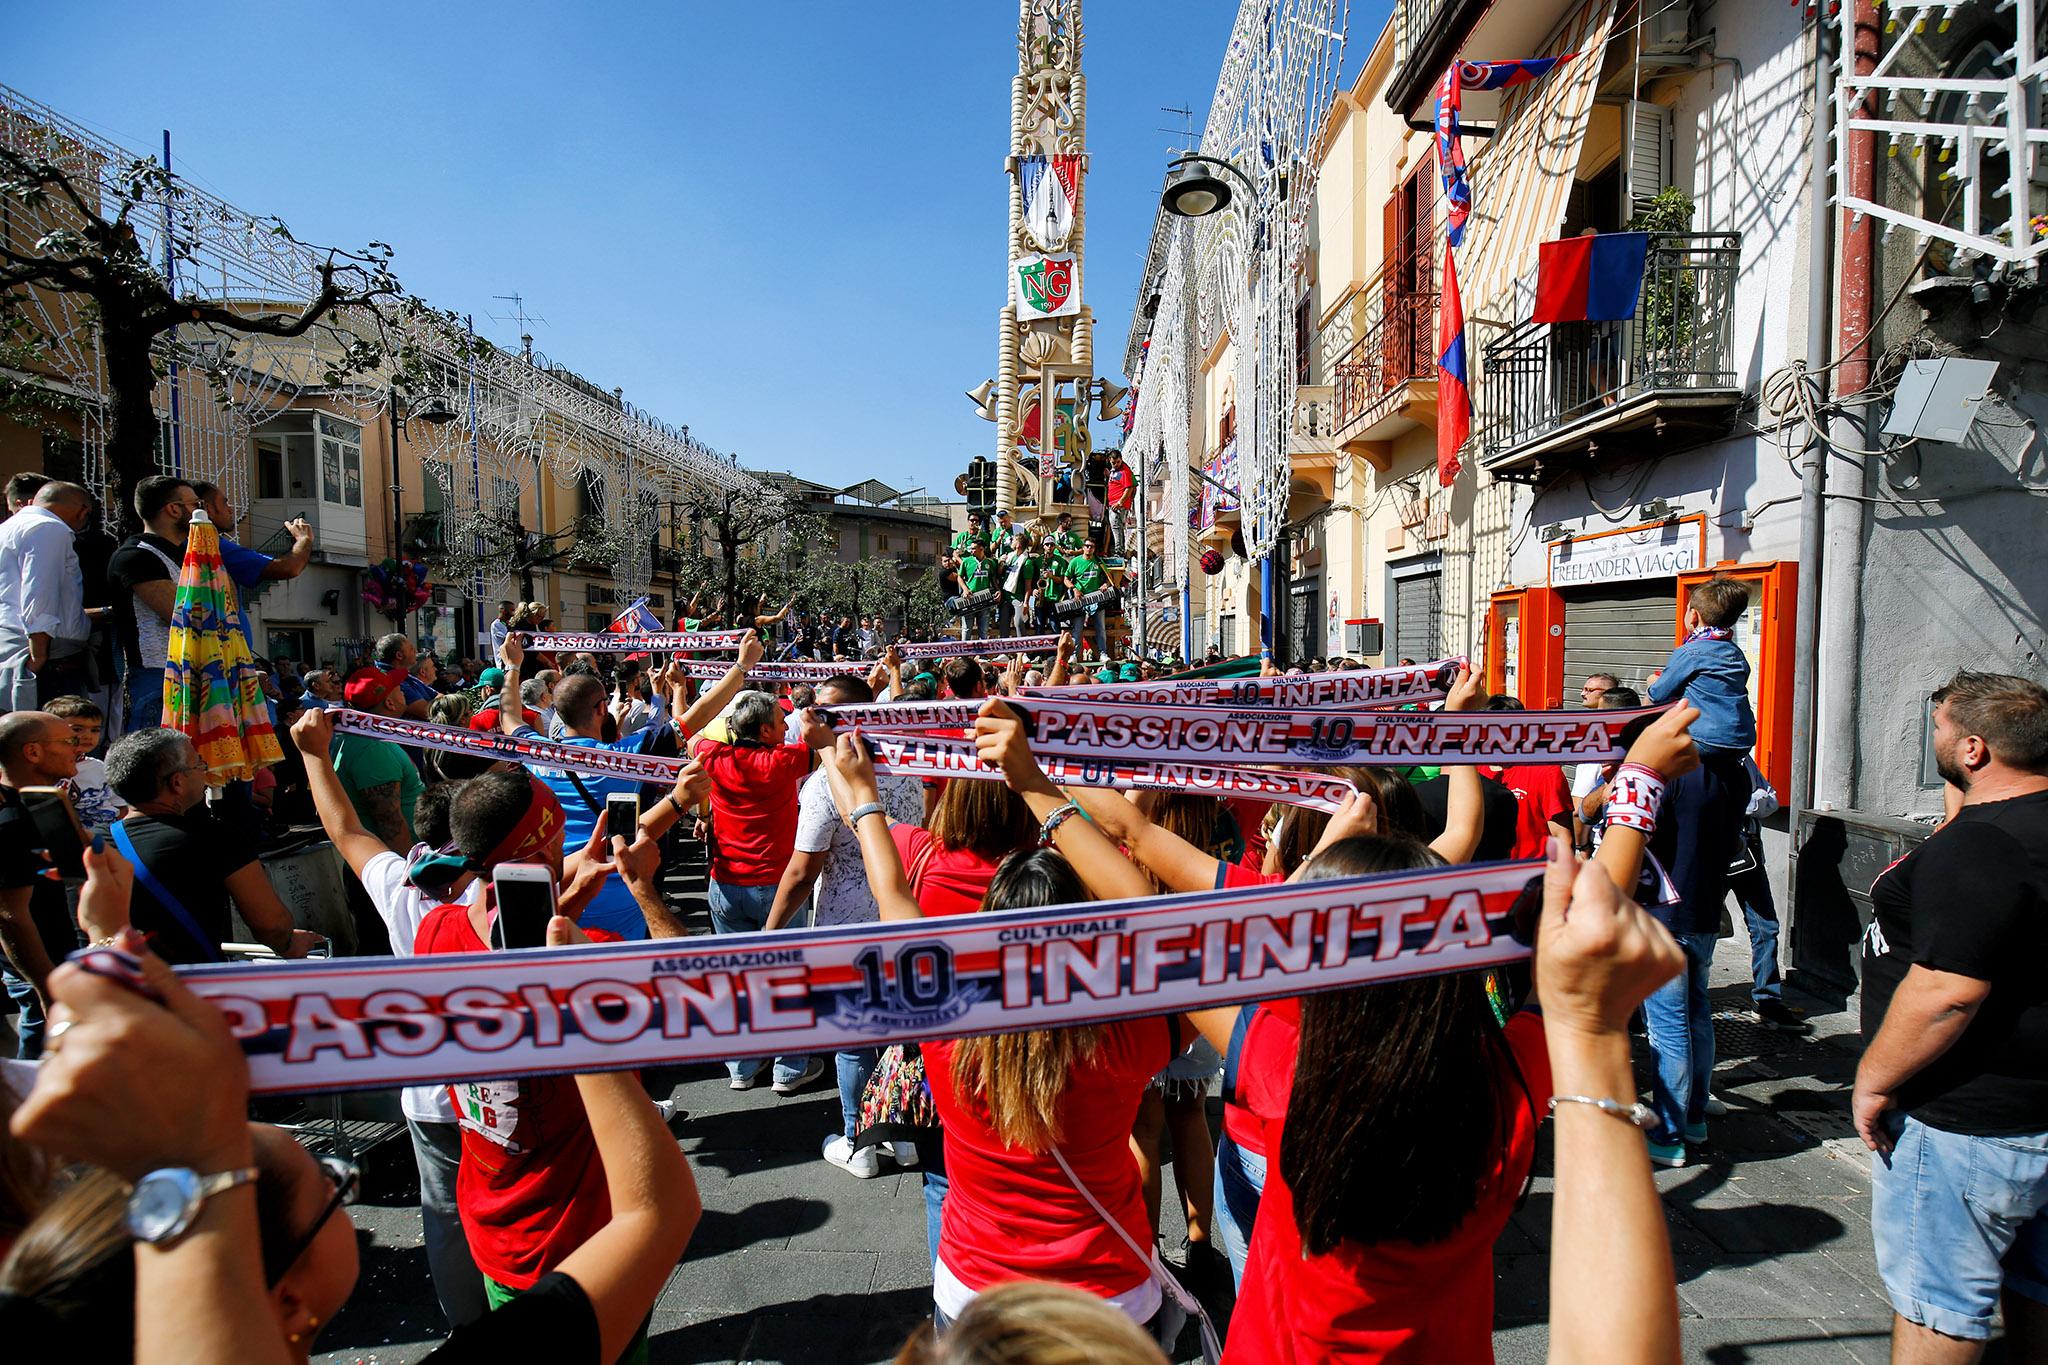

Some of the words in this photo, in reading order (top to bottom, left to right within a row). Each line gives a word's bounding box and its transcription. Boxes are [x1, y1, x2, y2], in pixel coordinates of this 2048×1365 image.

[1024, 270, 1070, 300] NG
[1041, 301, 1056, 310] 1991
[1552, 554, 1631, 582] FREELANDER
[1635, 549, 1694, 574] VIAGGI
[534, 636, 620, 649] PASSIONE
[626, 634, 641, 648] 10
[646, 636, 734, 649] INFINITA
[907, 643, 970, 656] PASSIONE
[989, 638, 1053, 651] INFINITA
[691, 663, 765, 677] PASSE
[787, 666, 865, 679] INFINITA
[1272, 675, 1310, 684] CULTURALE
[1051, 686, 1219, 704] SIONE
[1231, 681, 1261, 704] 10
[1272, 670, 1432, 707] INFINITA
[838, 705, 969, 726] INFINITA
[1227, 712, 1292, 721] ASSOCIAZIONE
[1375, 716, 1435, 724] CULTURALE
[340, 710, 484, 750] PASSIONE
[528, 744, 676, 780] INFINITA
[1034, 709, 1292, 753] PASSIONE
[1311, 716, 1356, 751] 10
[1368, 722, 1613, 755] INFINITA
[651, 949, 805, 974] ASSOCIAZIONE
[998, 917, 1128, 943] CULTURALE
[202, 965, 817, 1064] PASSIONE
[853, 940, 957, 1013] 10
[1001, 889, 1493, 1010] INFINITA
[466, 1098, 498, 1128] NG
